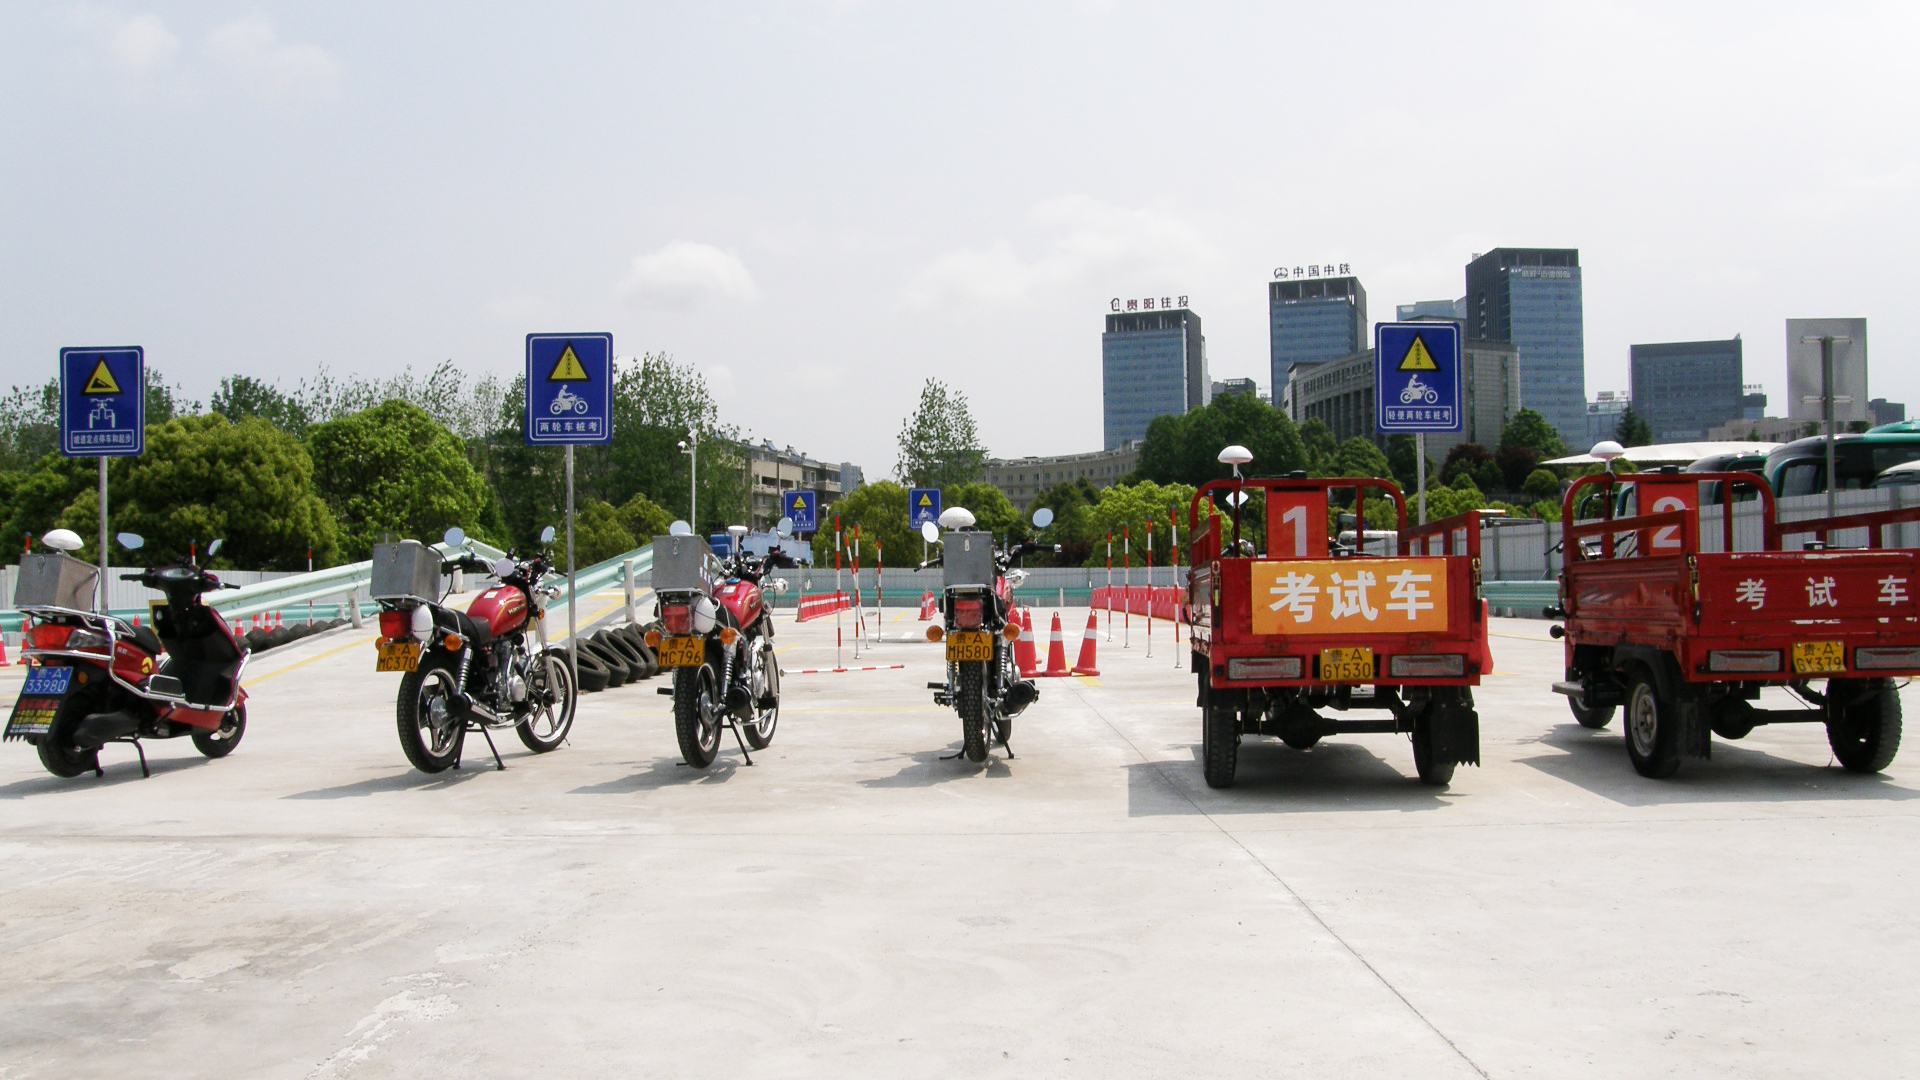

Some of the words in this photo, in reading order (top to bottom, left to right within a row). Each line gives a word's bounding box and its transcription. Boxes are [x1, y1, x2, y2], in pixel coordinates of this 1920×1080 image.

[1293, 263, 1351, 278] 中国中铁
[1127, 295, 1189, 311] 贵阳住投
[1388, 410, 1450, 420] 轻便两轮车桩考
[539, 421, 598, 432] 两轮车桩考
[1652, 496, 1684, 548] 2
[1282, 505, 1307, 557] 1
[1269, 569, 1434, 623] 考试车
[1735, 574, 1909, 610] 考试车
[660, 650, 702, 664] MC796
[948, 645, 991, 659] MH580
[379, 656, 417, 671] MC370
[1323, 662, 1371, 679] GY530
[26, 679, 67, 692] 33980
